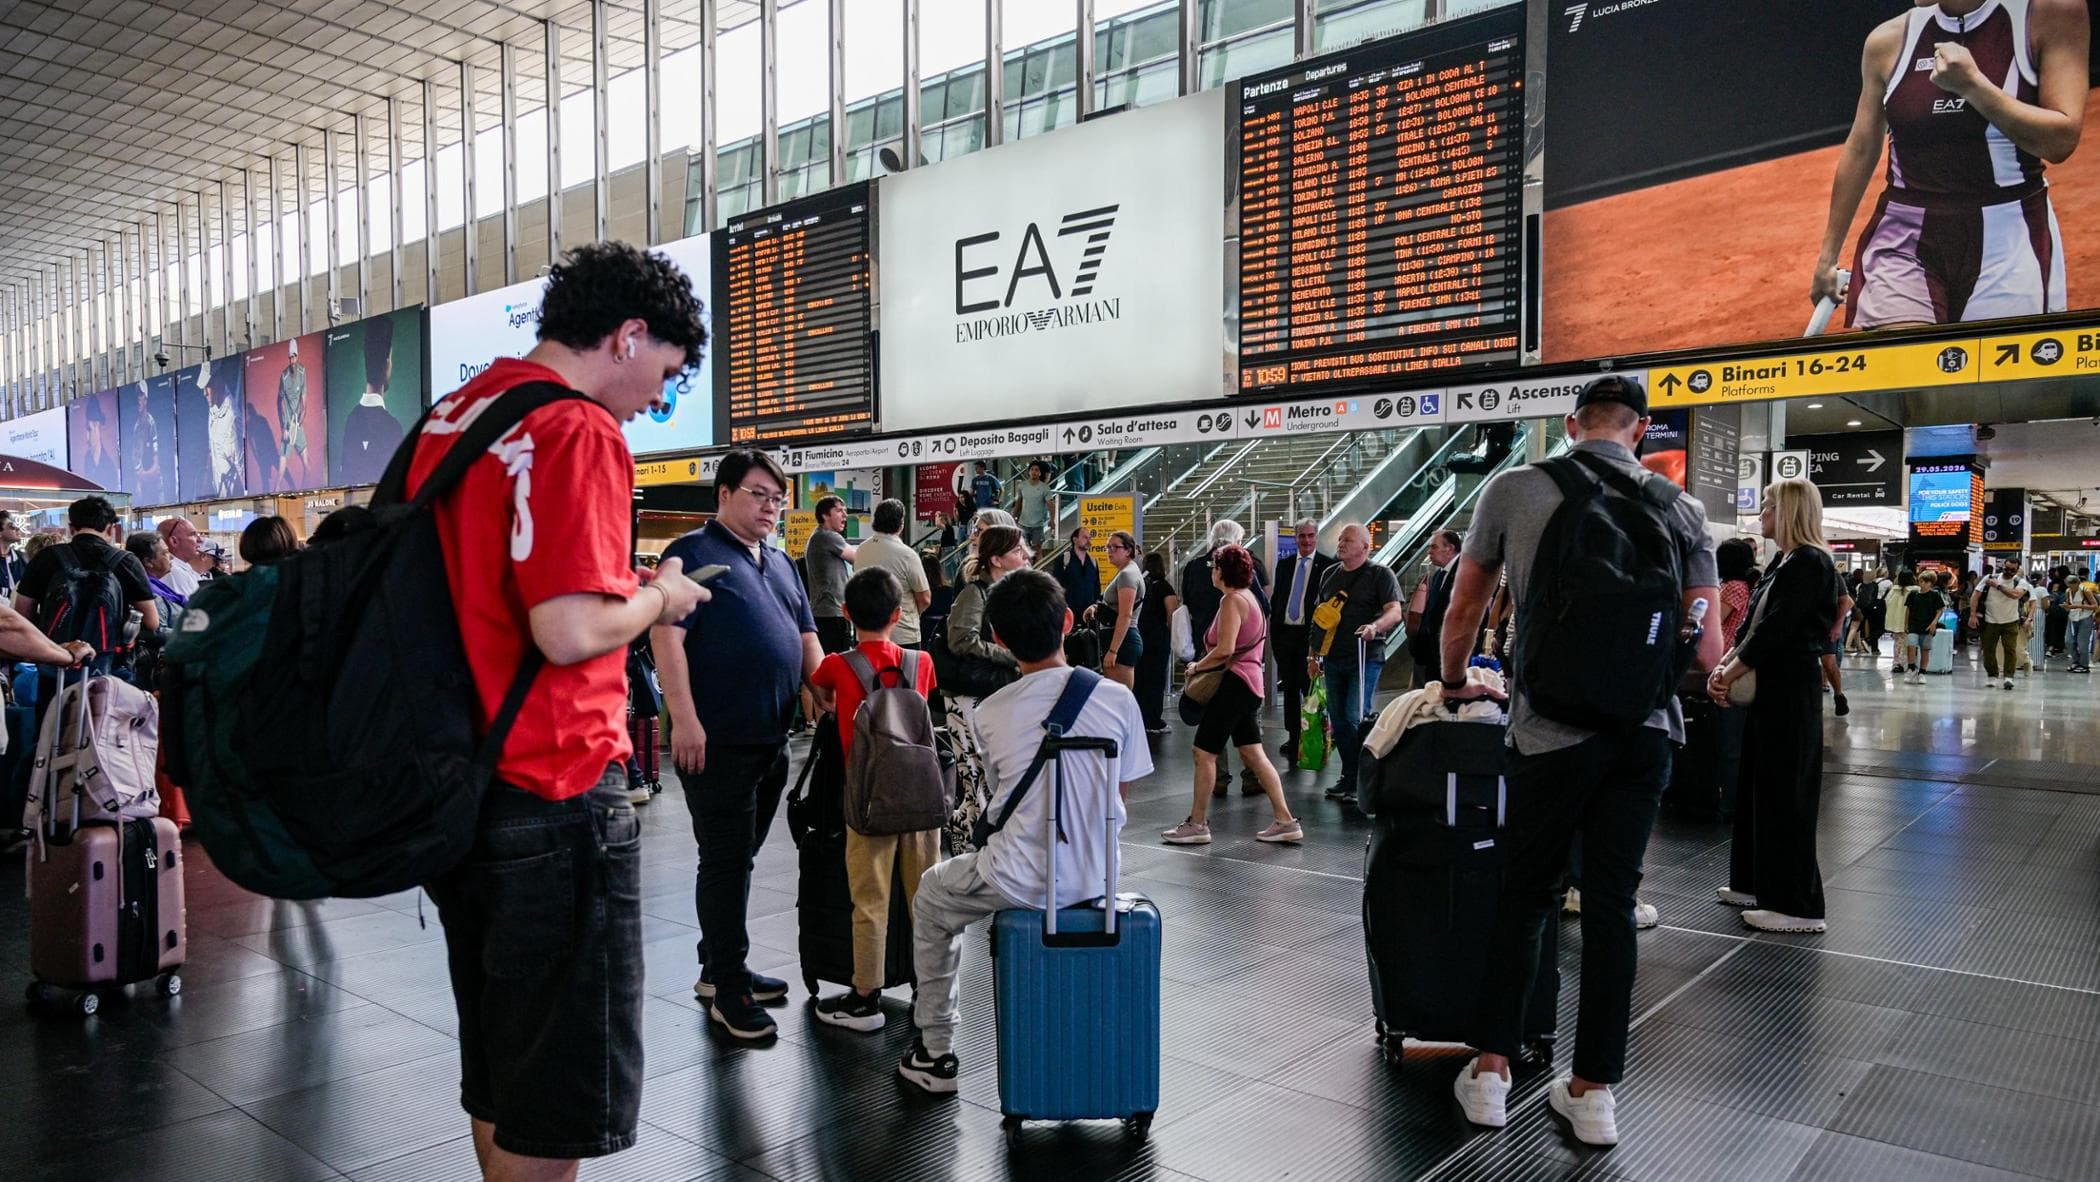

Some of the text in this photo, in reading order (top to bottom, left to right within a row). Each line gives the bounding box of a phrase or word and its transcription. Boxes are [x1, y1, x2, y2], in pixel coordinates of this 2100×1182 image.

[1592, 4, 1620, 18] LUCIA
[1243, 79, 1289, 99] Partenze
[1305, 63, 1347, 80] Departures
[1932, 99, 1966, 111] EA7
[956, 203, 1120, 315] EA7
[956, 298, 1120, 343] EMPORIO ARMANI
[1722, 354, 1866, 382] Binari 16-24
[1721, 384, 1775, 397] Platforms
[1265, 410, 1280, 425] M
[1287, 405, 1331, 419] Metro
[1507, 403, 1521, 414] Lift
[1097, 420, 1177, 435] Sala d'attesa
[1287, 418, 1339, 431] Underground
[1645, 423, 1669, 431] ROMA
[960, 428, 1049, 448] Deposito Bagagli
[1097, 435, 1144, 446] Waiting Room
[1645, 431, 1678, 439] TERMINI
[805, 448, 844, 460] Fiumicino
[2031, 560, 2046, 572] M
